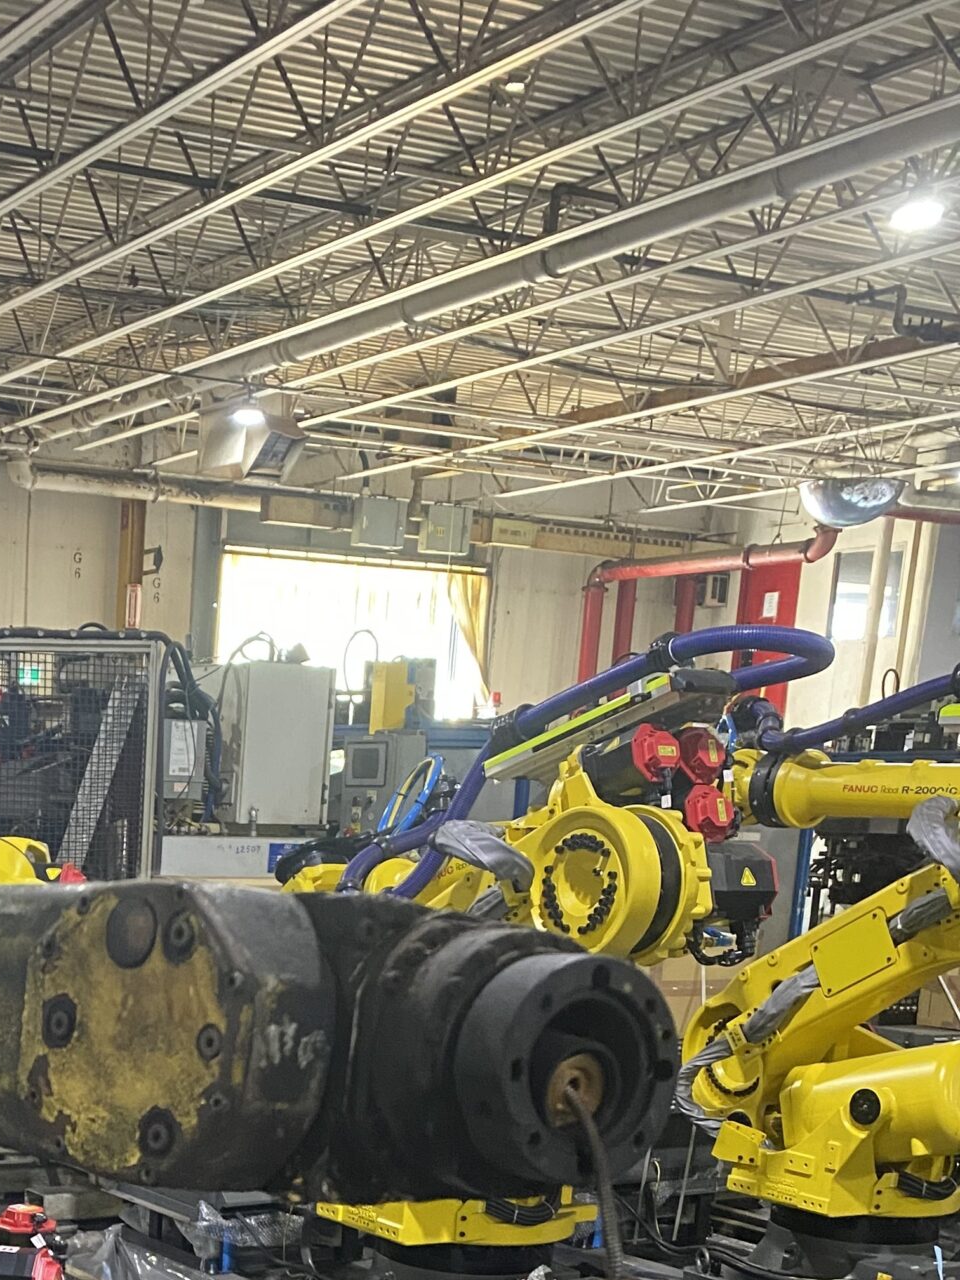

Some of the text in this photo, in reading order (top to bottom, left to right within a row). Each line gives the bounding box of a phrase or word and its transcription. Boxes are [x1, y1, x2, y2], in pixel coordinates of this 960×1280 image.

[73, 552, 82, 564] G
[152, 577, 161, 588] G
[842, 784, 879, 794] FANUC
